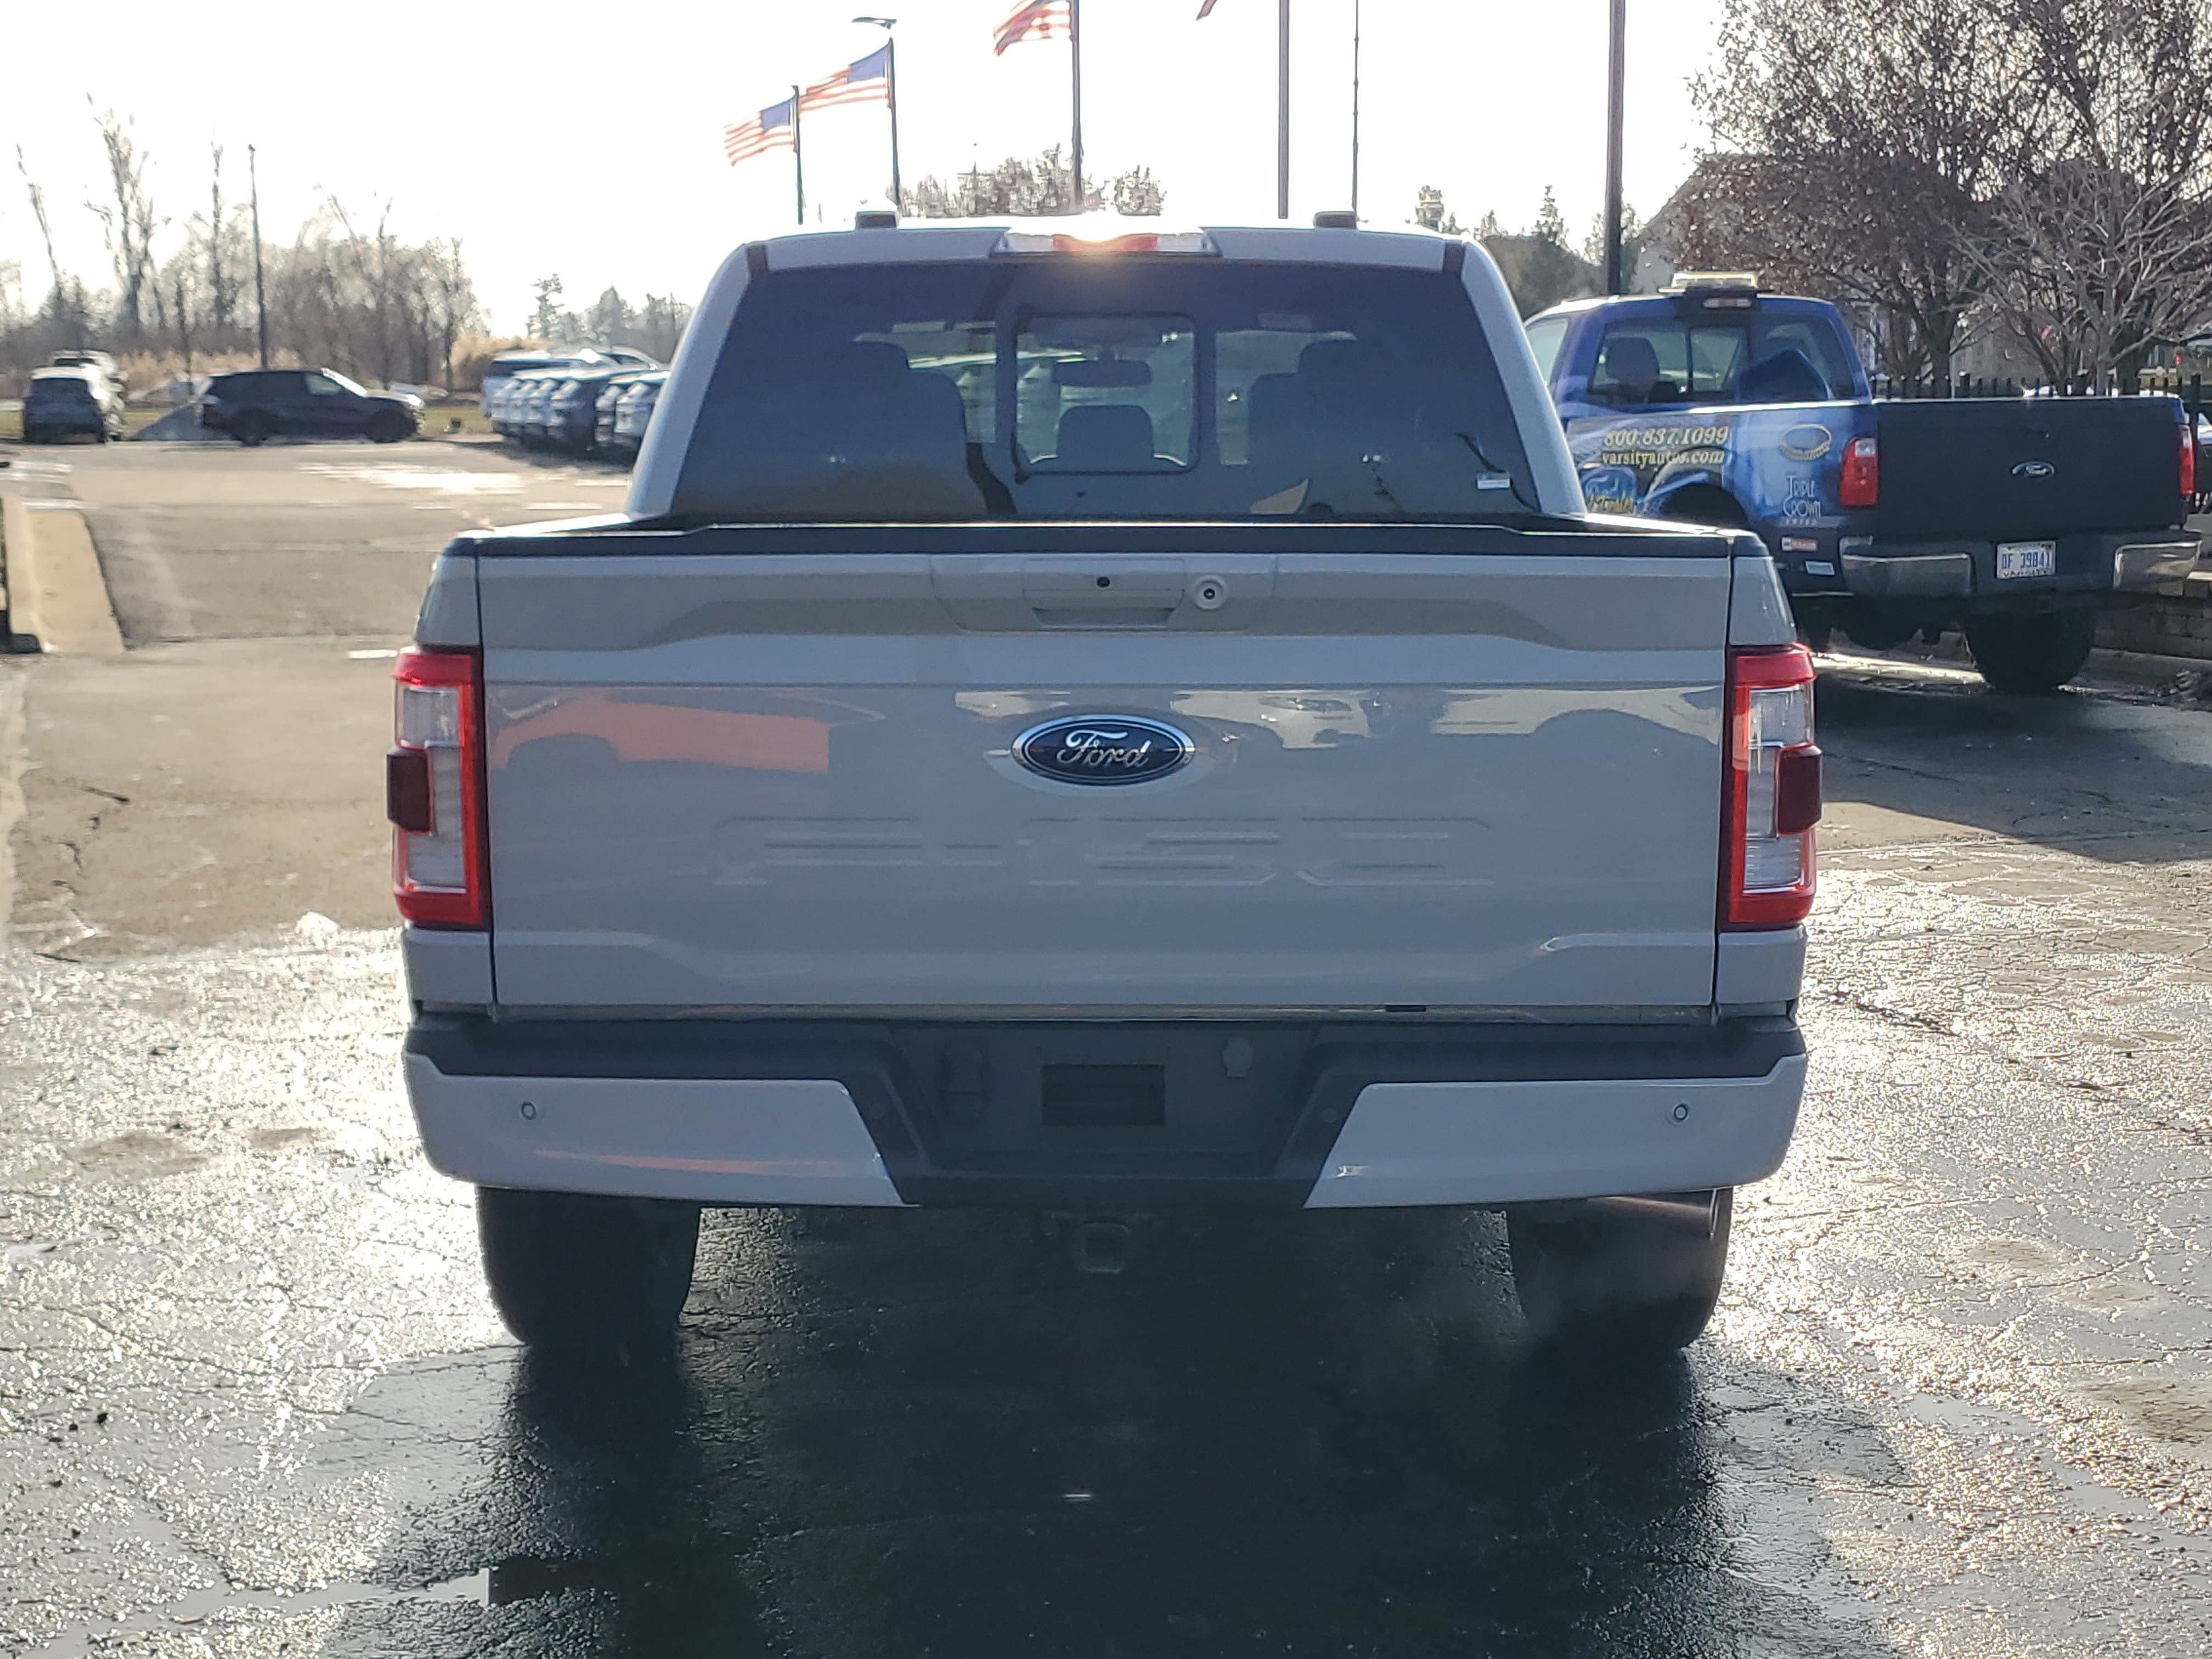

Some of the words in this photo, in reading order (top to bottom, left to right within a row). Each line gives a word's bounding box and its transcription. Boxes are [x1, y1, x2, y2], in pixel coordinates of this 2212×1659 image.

[1603, 426, 1729, 447] 800.837.1099
[1601, 449, 1725, 470] varsityautos.com
[1056, 729, 1151, 767] Ford
